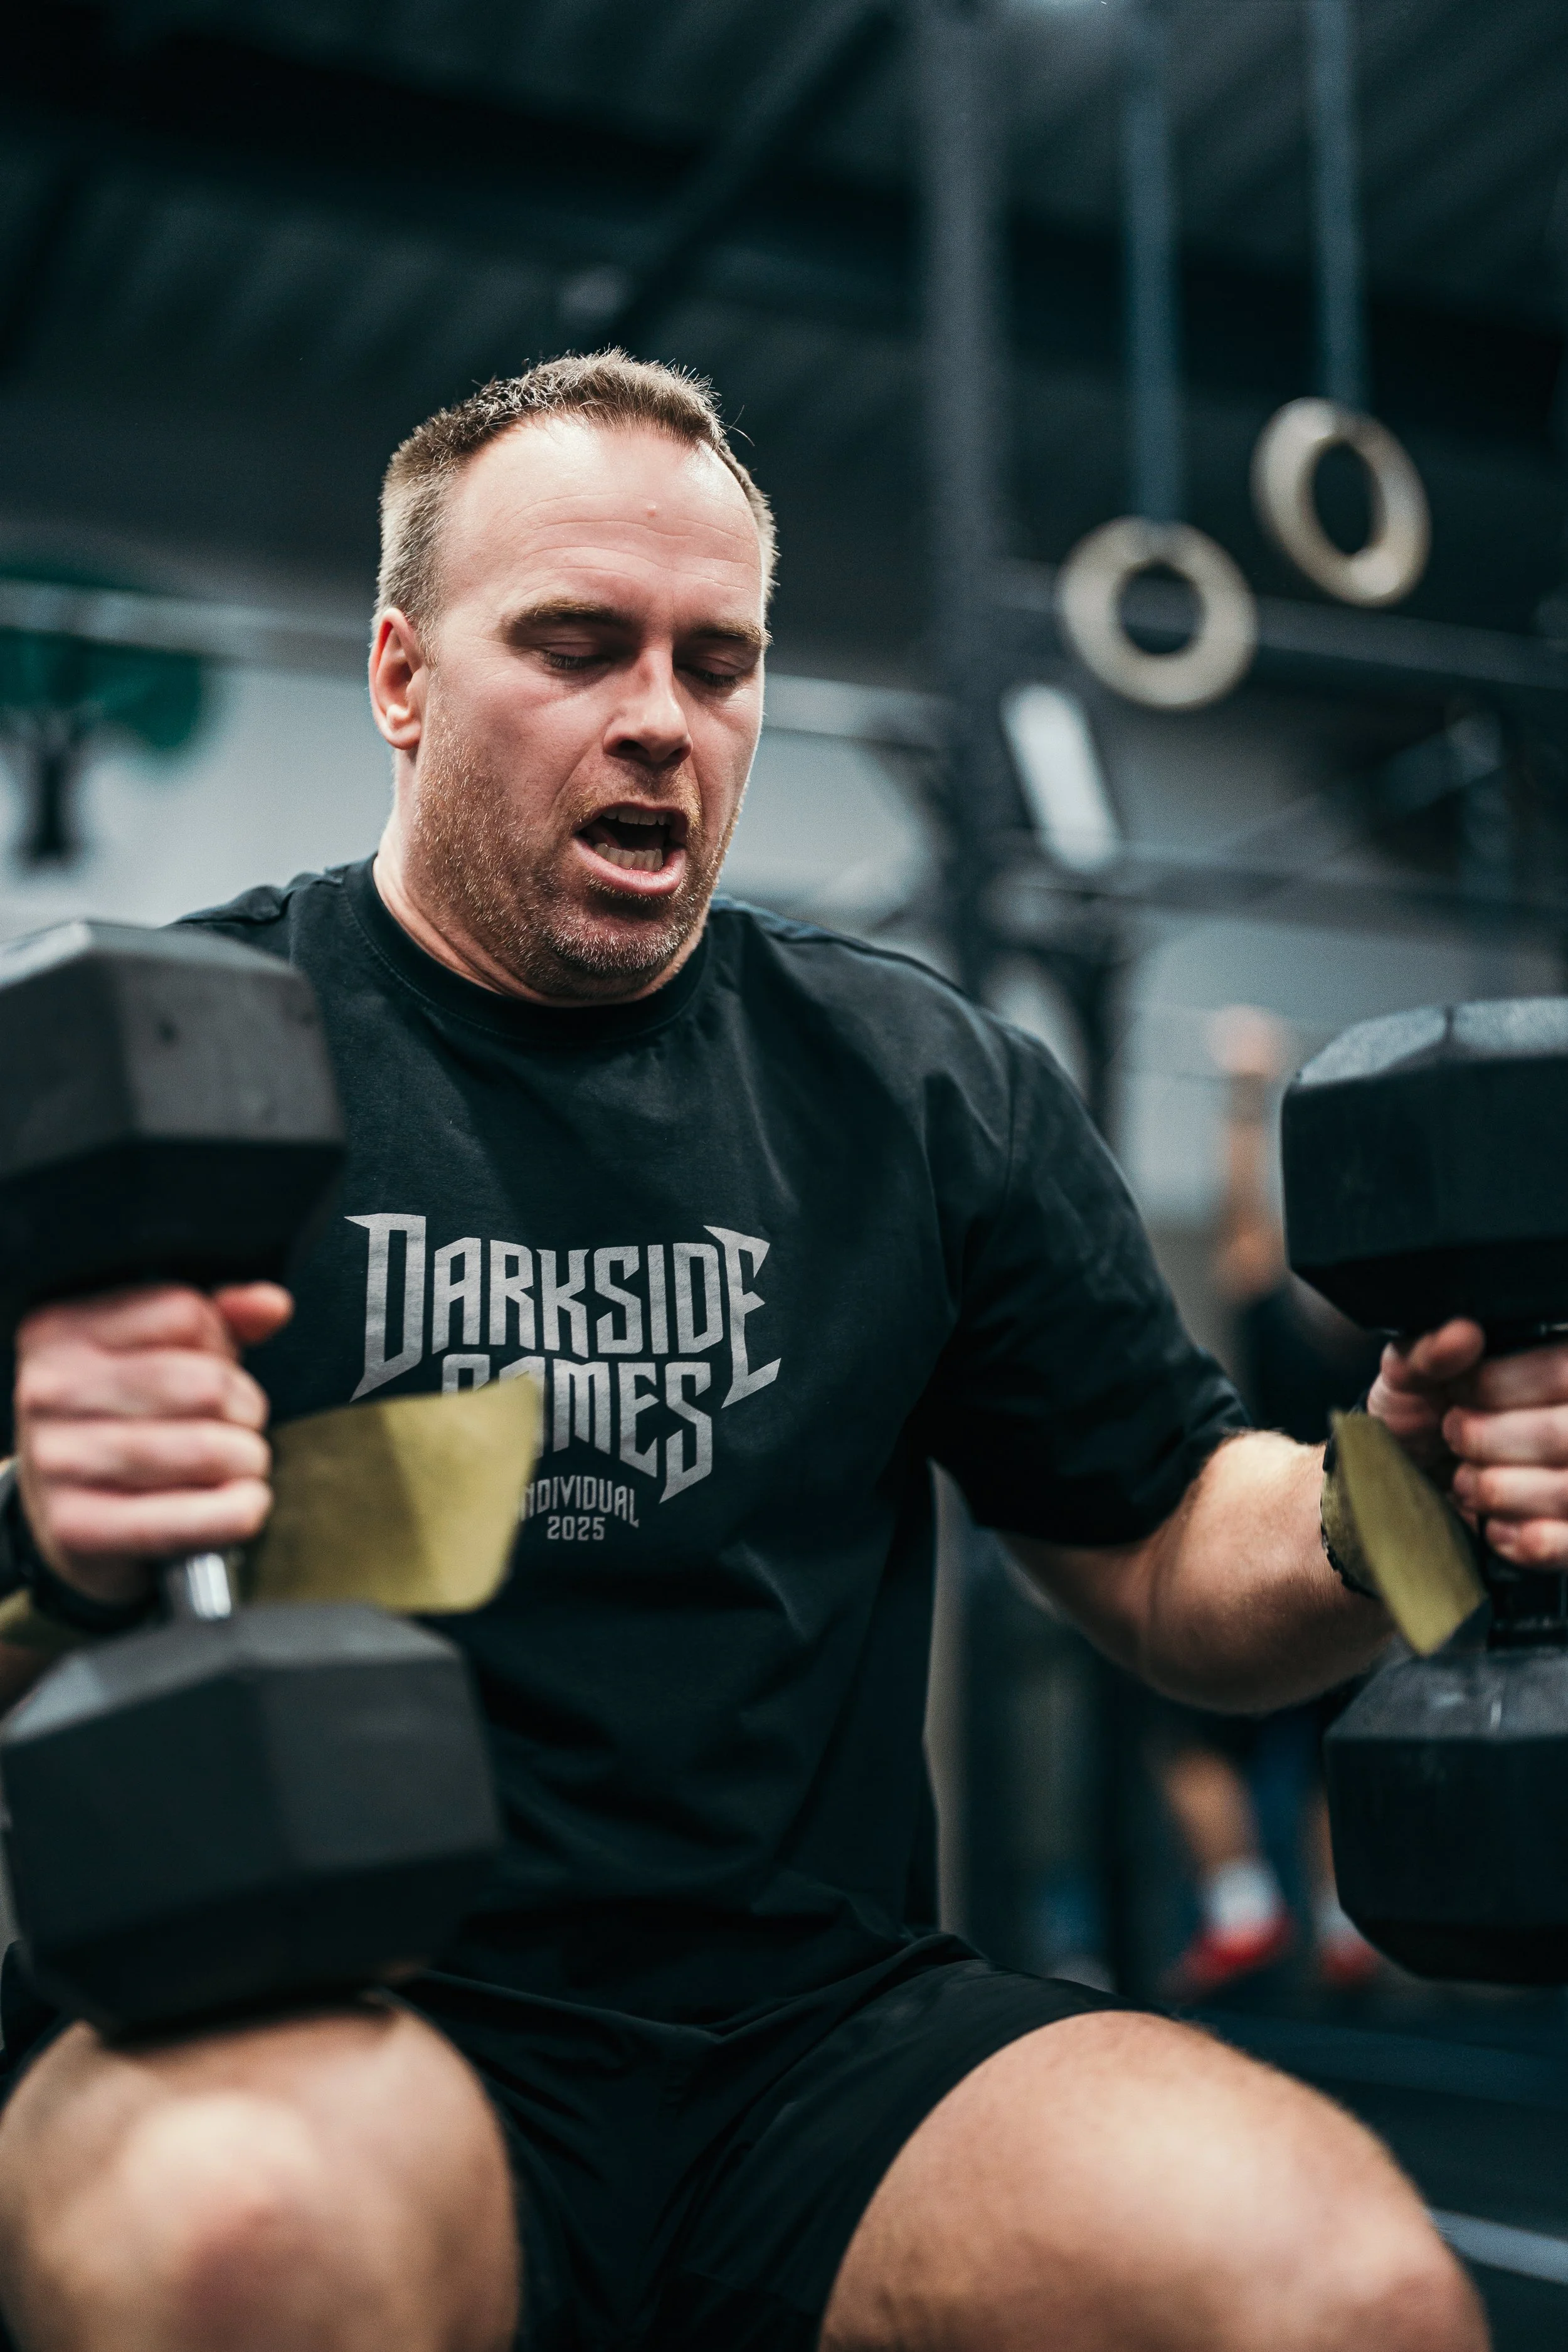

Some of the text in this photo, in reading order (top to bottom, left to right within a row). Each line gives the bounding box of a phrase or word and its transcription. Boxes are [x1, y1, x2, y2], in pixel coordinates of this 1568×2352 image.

[344, 1213, 781, 1409] DARKSIDE
[520, 1475, 639, 1528] NDIVIDUAL
[547, 1516, 606, 1541] 2025
